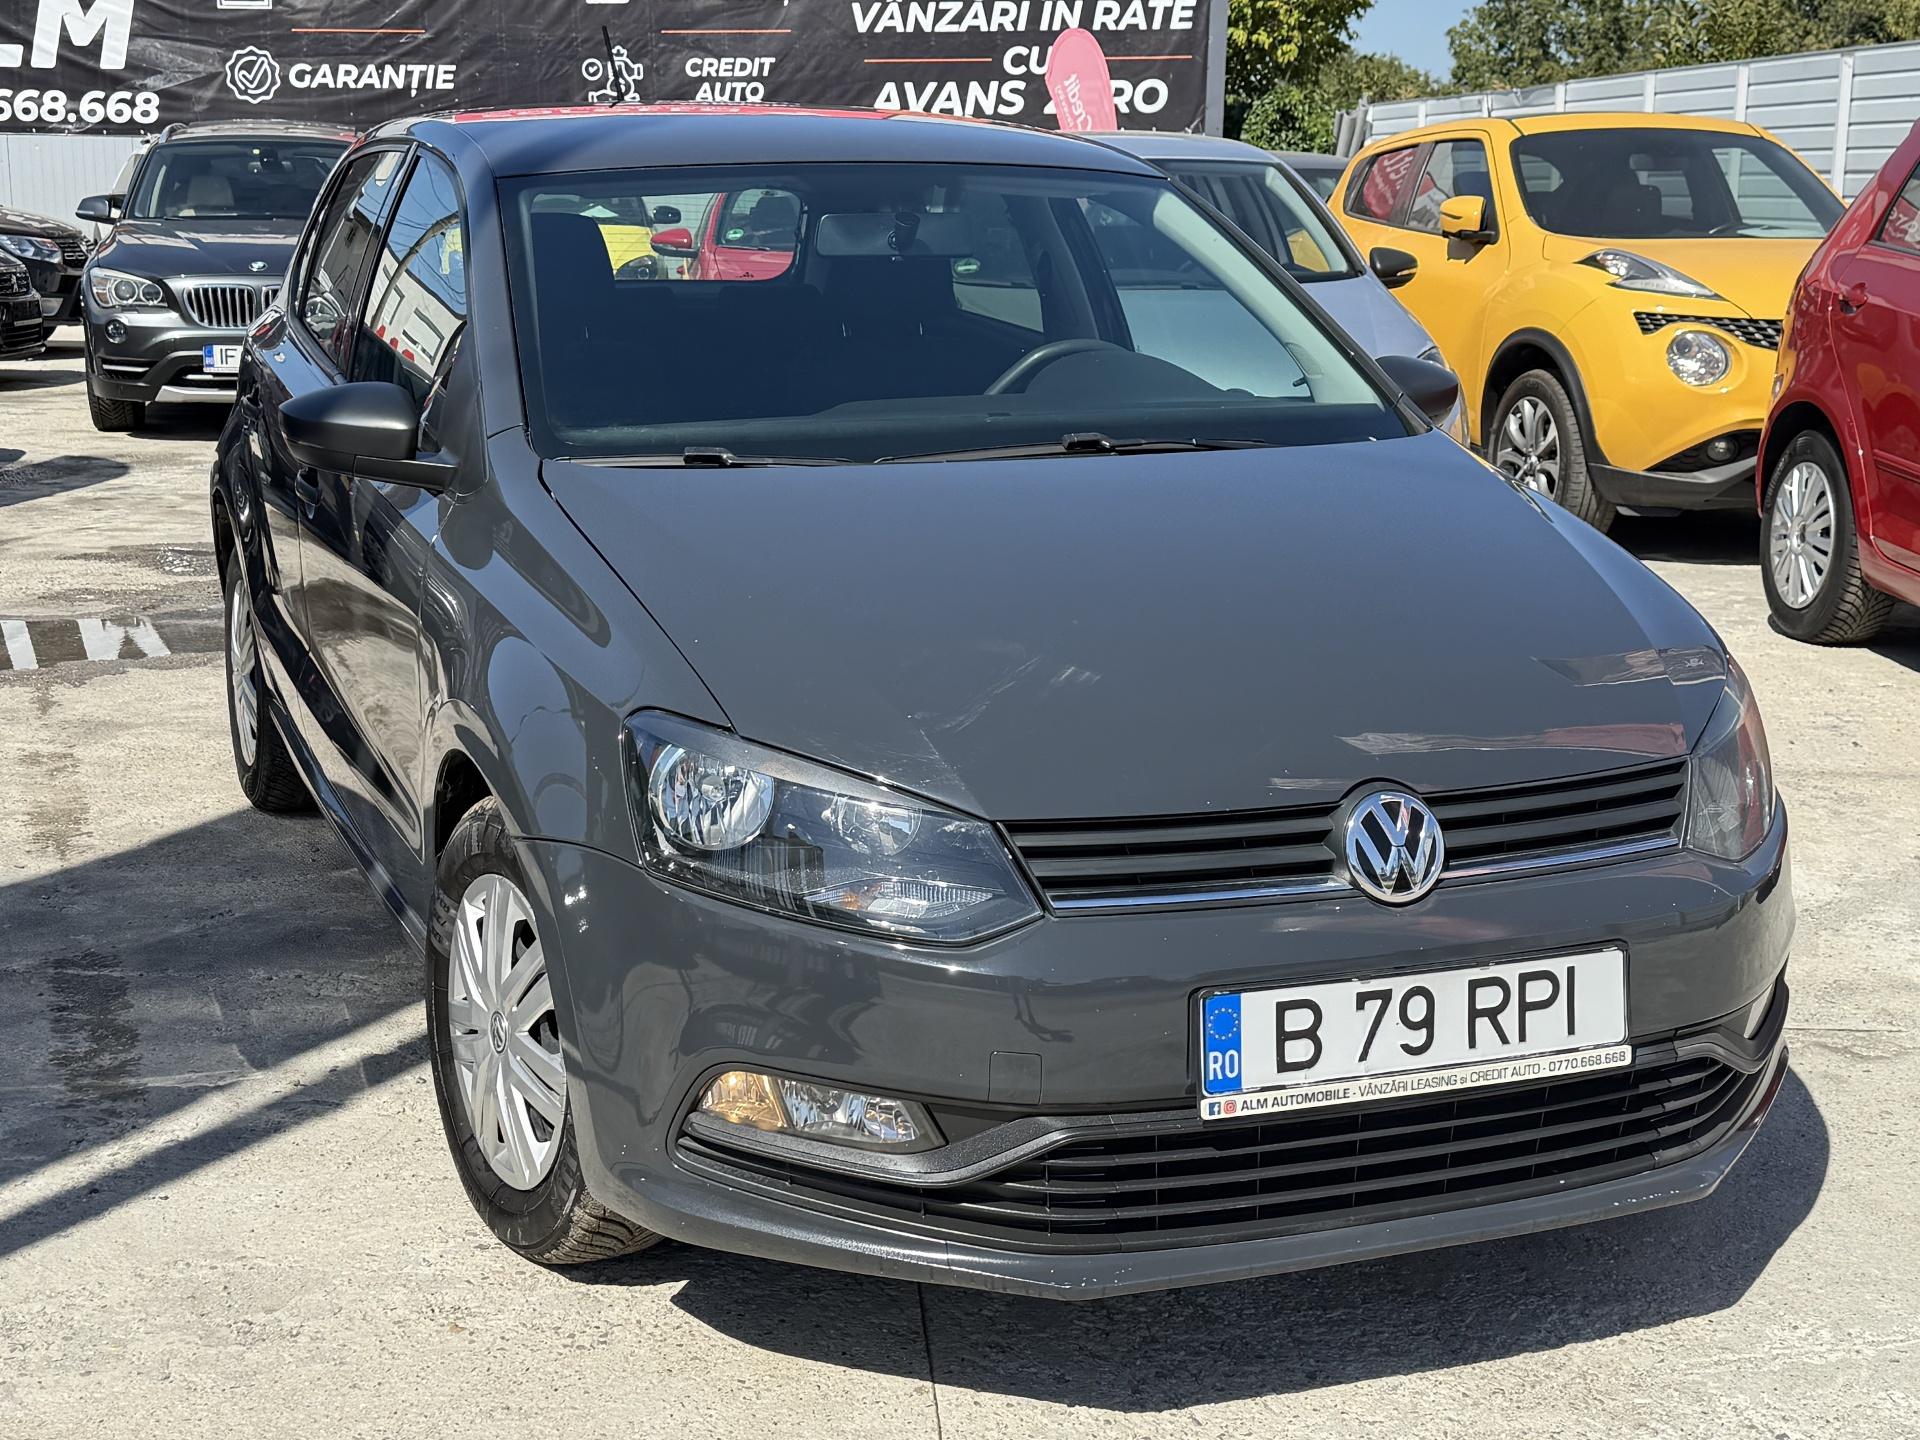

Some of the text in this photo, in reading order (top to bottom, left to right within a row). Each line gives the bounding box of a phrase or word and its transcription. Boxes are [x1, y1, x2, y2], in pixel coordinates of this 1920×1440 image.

[1092, 0, 1198, 31] RATE
[684, 57, 776, 78] CREDIT
[1002, 45, 1053, 76] CU
[695, 82, 765, 102] AUTO
[873, 80, 1027, 117] AVANS
[1275, 965, 1576, 1074] B 79 RPI
[1208, 1049, 1239, 1081] RO
[1240, 1098, 1268, 1112] ALM
[1271, 1087, 1350, 1108] AUTOMOBILE
[1411, 1074, 1457, 1091] LEASING
[1470, 1066, 1509, 1083] CREDIT
[1511, 1063, 1541, 1078] AUTO
[1548, 1050, 1626, 1072] 0770.668.668
